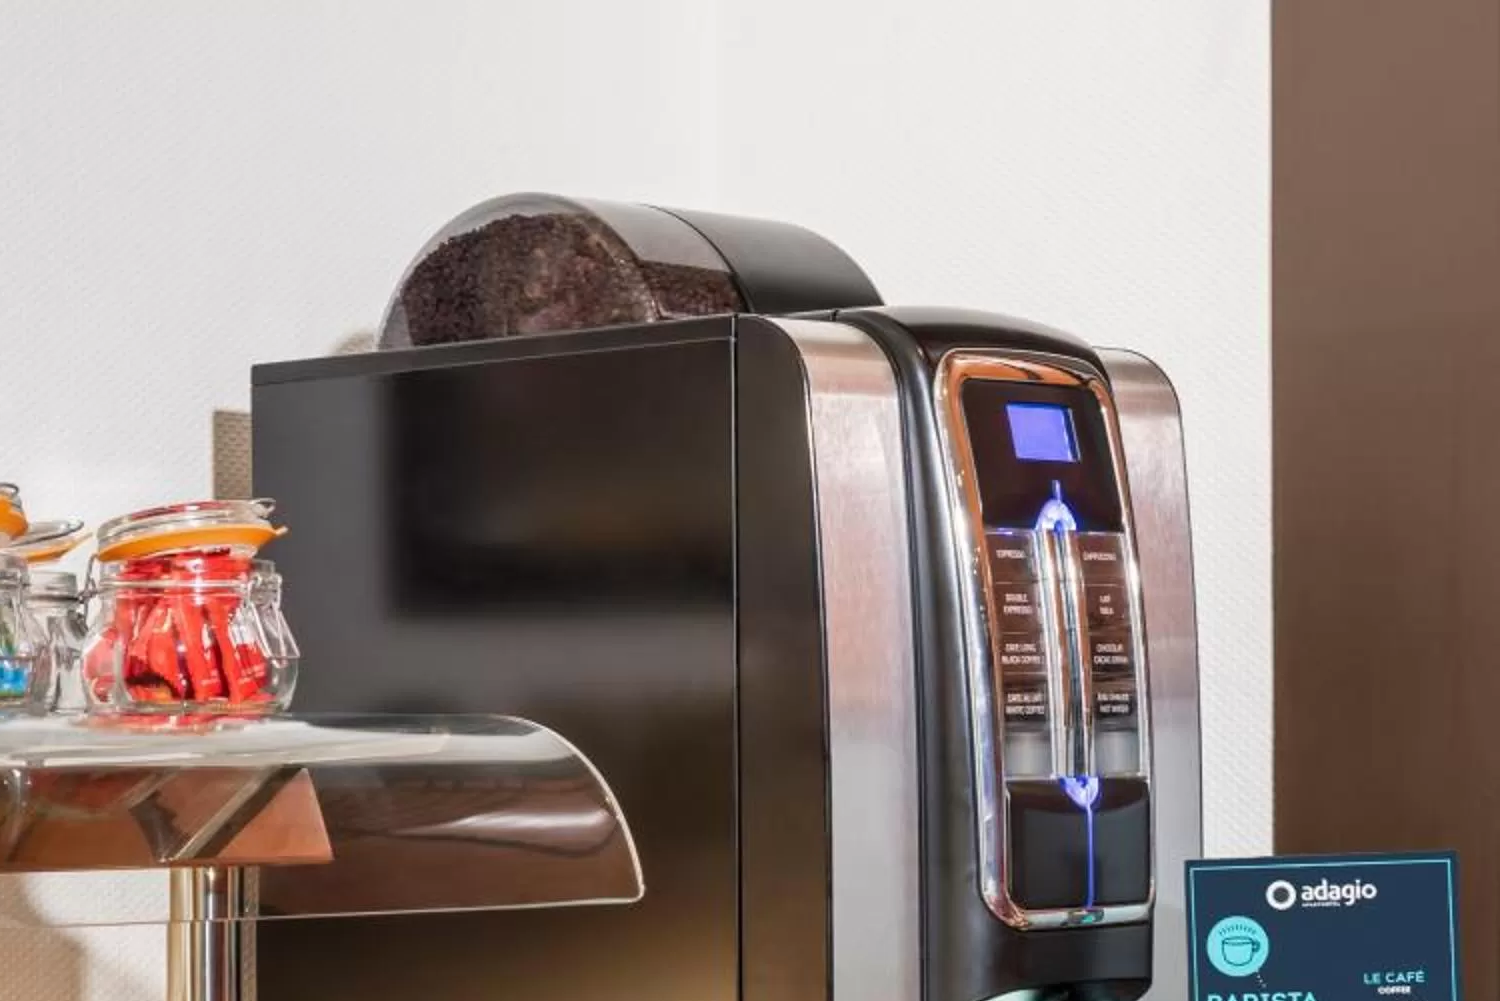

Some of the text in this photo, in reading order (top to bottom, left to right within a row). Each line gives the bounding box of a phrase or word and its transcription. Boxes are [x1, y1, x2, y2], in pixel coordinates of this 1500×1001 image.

[1301, 878, 1377, 906] adagio
[1364, 969, 1425, 984] LE CAFÉ
